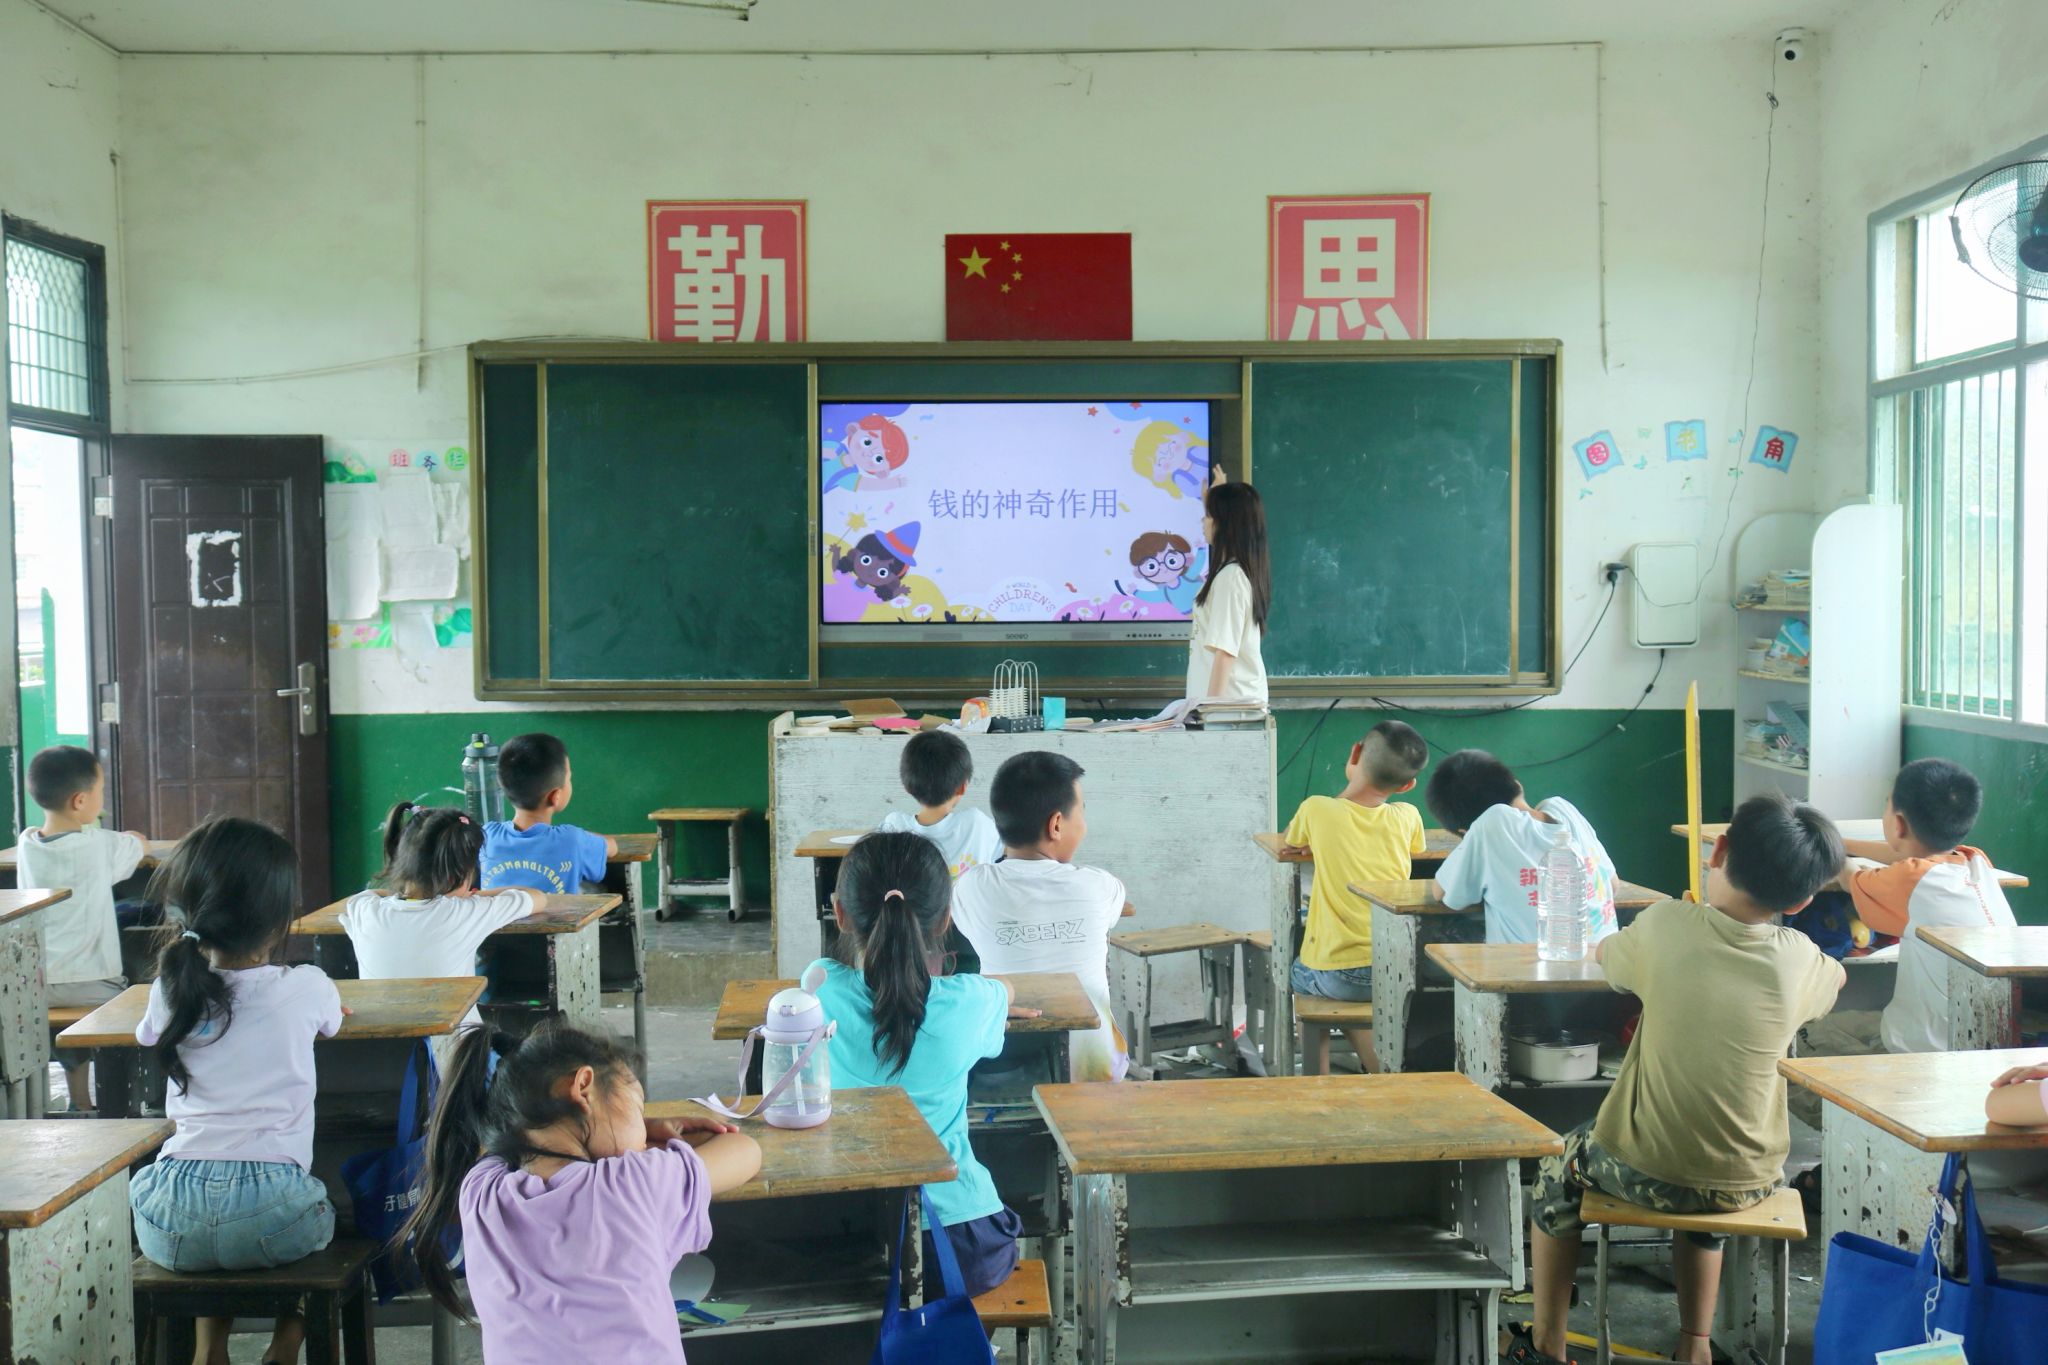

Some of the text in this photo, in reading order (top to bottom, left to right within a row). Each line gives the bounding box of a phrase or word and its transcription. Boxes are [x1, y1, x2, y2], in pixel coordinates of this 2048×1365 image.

[667, 224, 787, 343] 勤
[1288, 218, 1412, 341] 思
[391, 451, 466, 472] 班务栏
[1766, 436, 1785, 463] 角
[928, 488, 1118, 520] 钱的神奇作用
[988, 589, 1056, 613] CHILDREN'S
[1009, 603, 1033, 612] DAY
